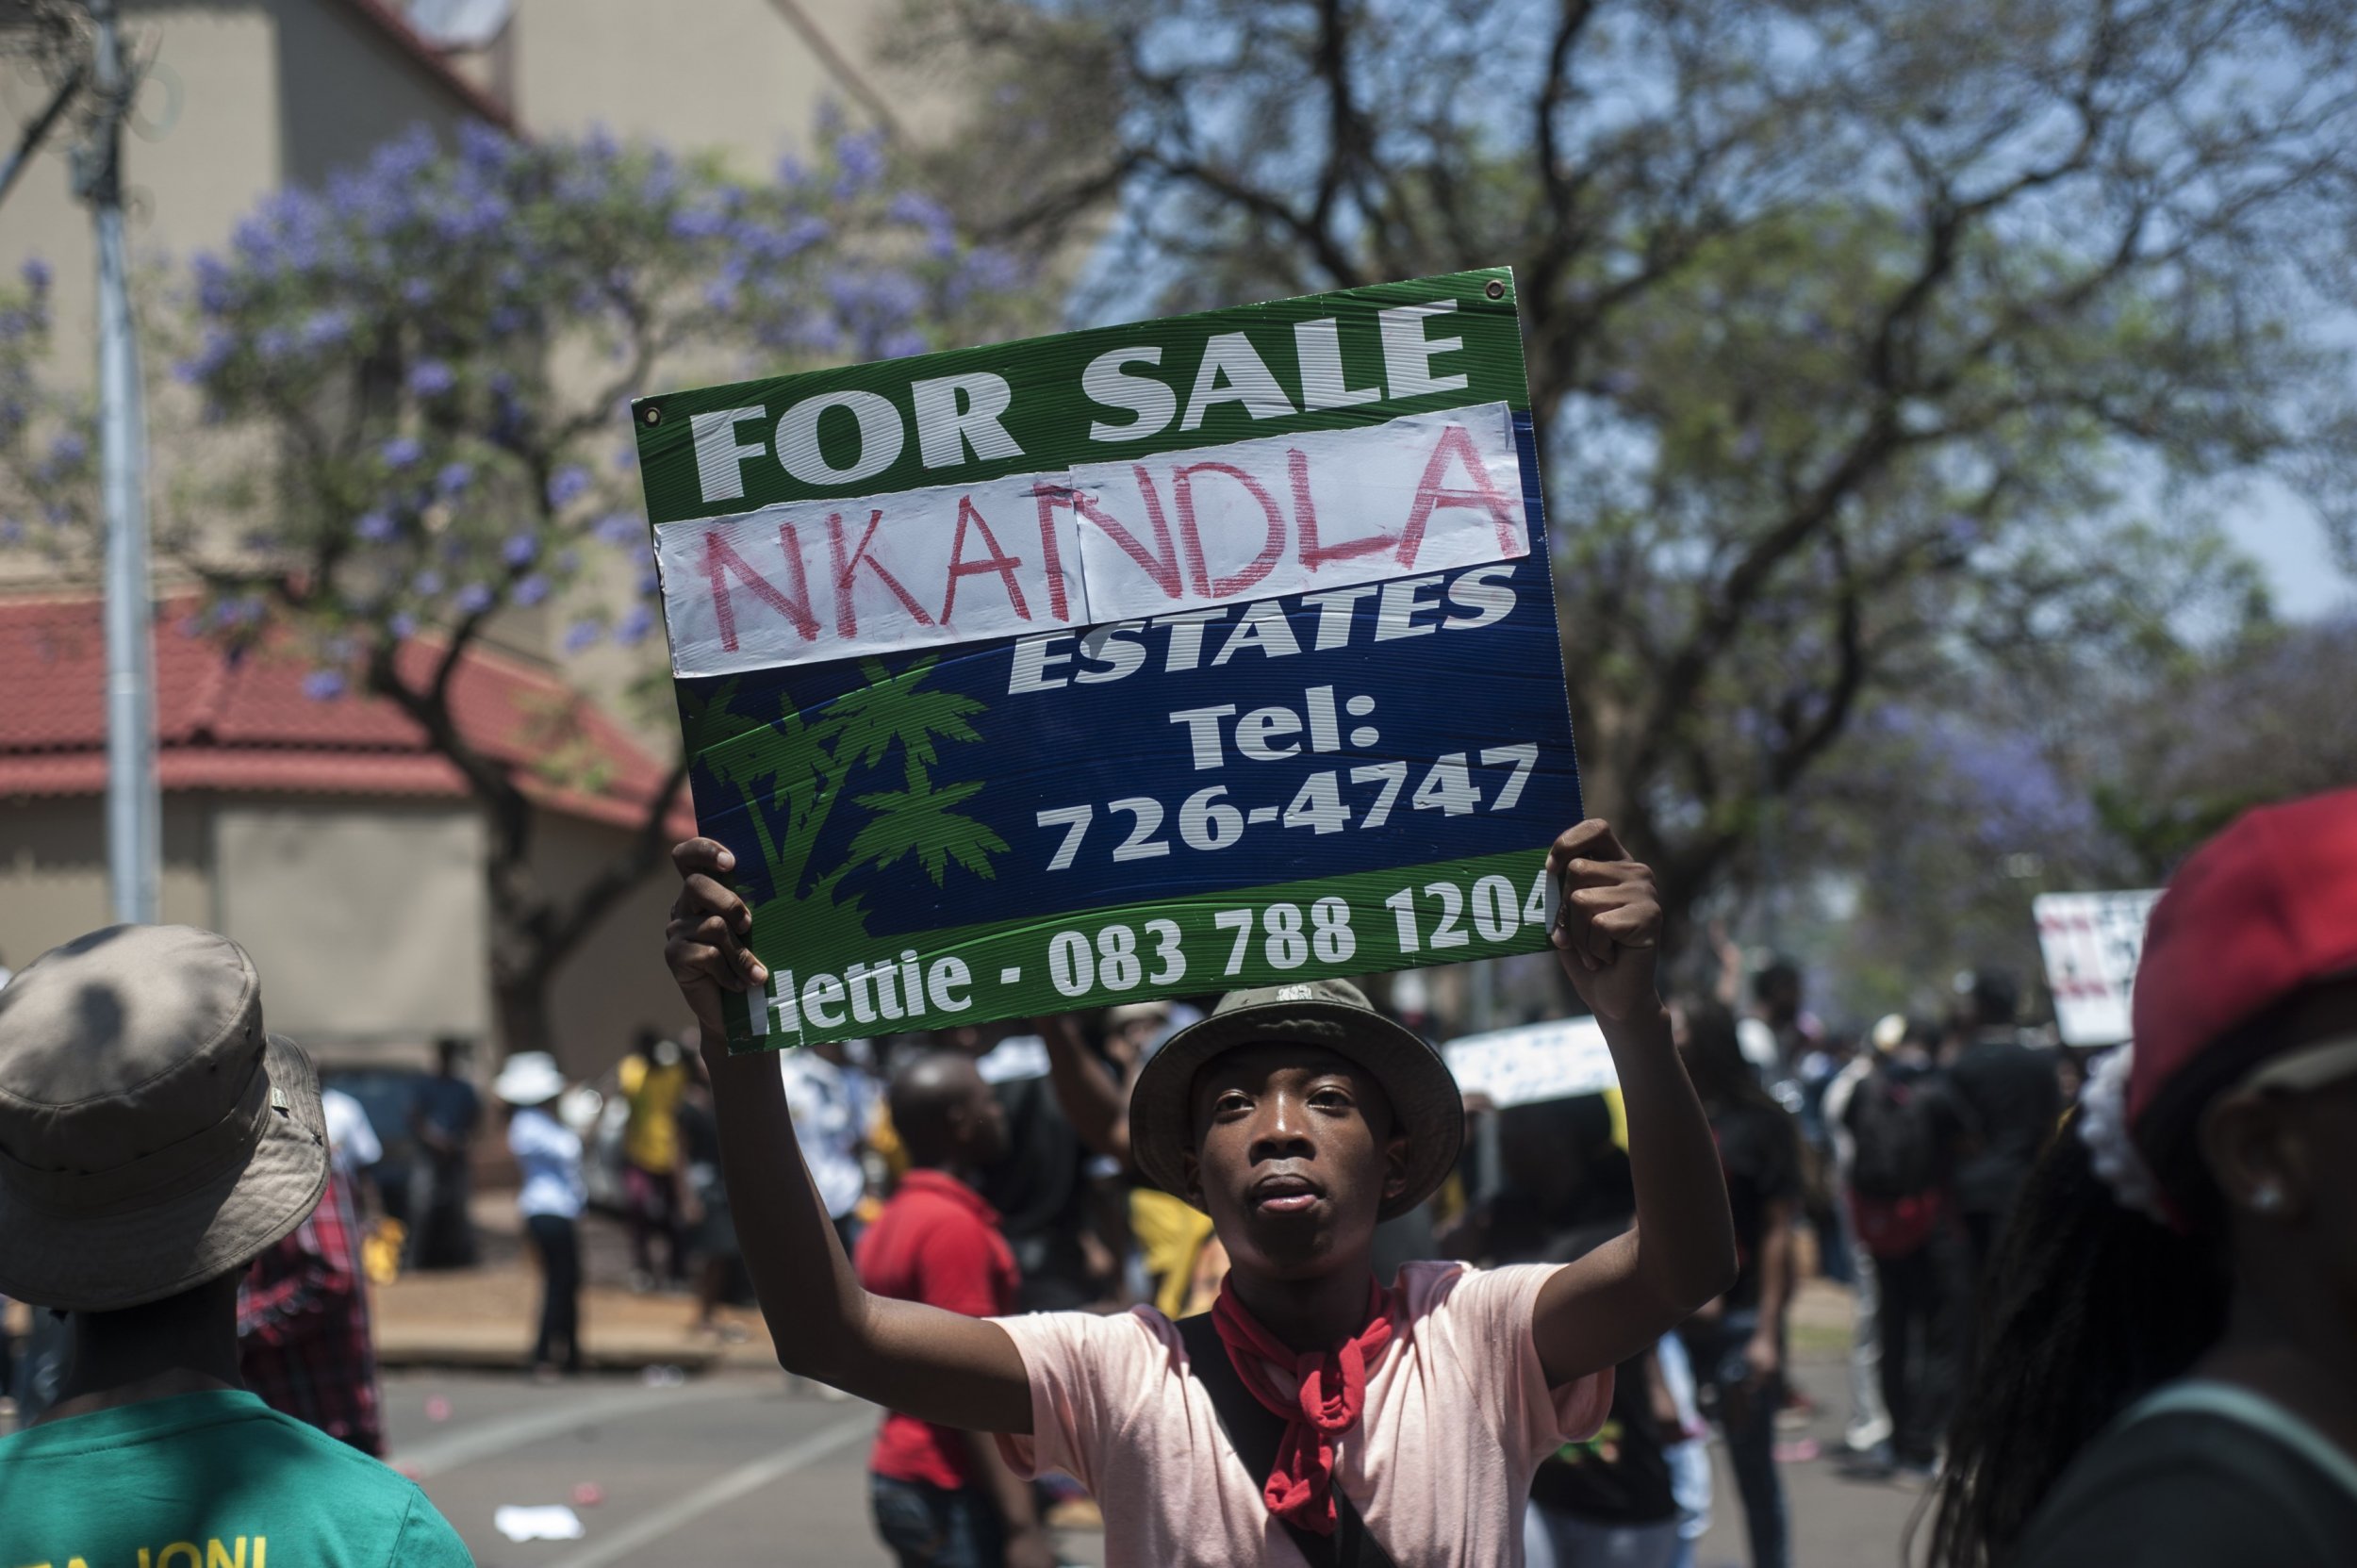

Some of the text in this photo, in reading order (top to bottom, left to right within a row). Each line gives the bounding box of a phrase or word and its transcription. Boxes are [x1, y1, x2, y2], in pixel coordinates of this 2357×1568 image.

[690, 299, 1468, 503] FOR SALE
[701, 425, 1520, 653] NKANDLA
[1008, 565, 1517, 695] ESTATES
[1169, 685, 1379, 770] Tel:
[1037, 742, 1539, 871] 726-4747
[746, 867, 1561, 1035] Hettie - 083 788 1204
